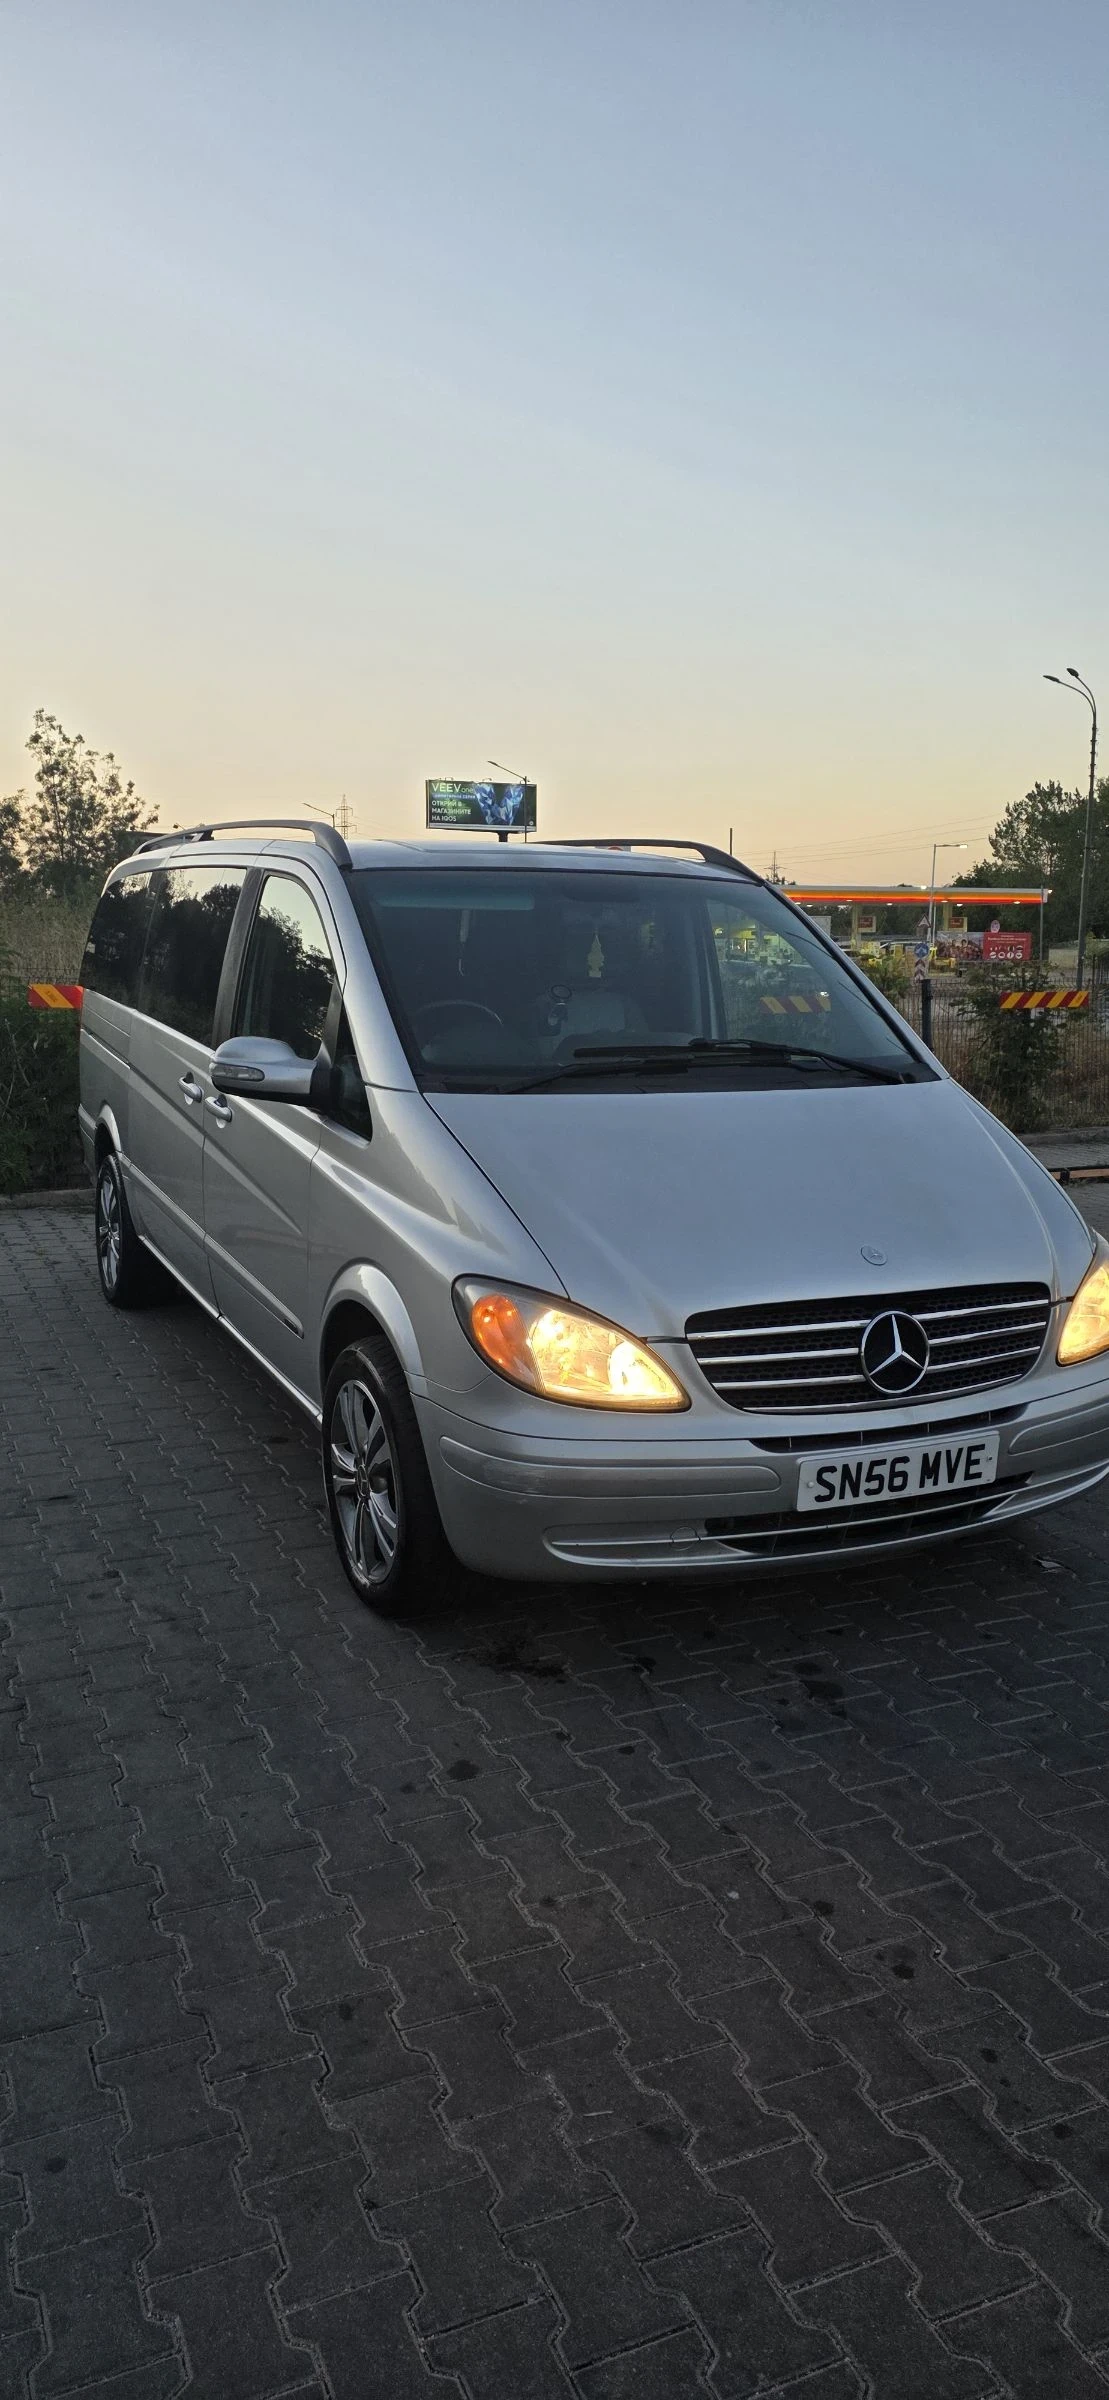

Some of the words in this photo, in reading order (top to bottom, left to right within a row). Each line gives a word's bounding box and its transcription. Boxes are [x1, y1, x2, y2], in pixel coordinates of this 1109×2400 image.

[431, 783, 462, 792] VEEV
[814, 1455, 910, 1503] SN56
[918, 1443, 986, 1489] MVE
